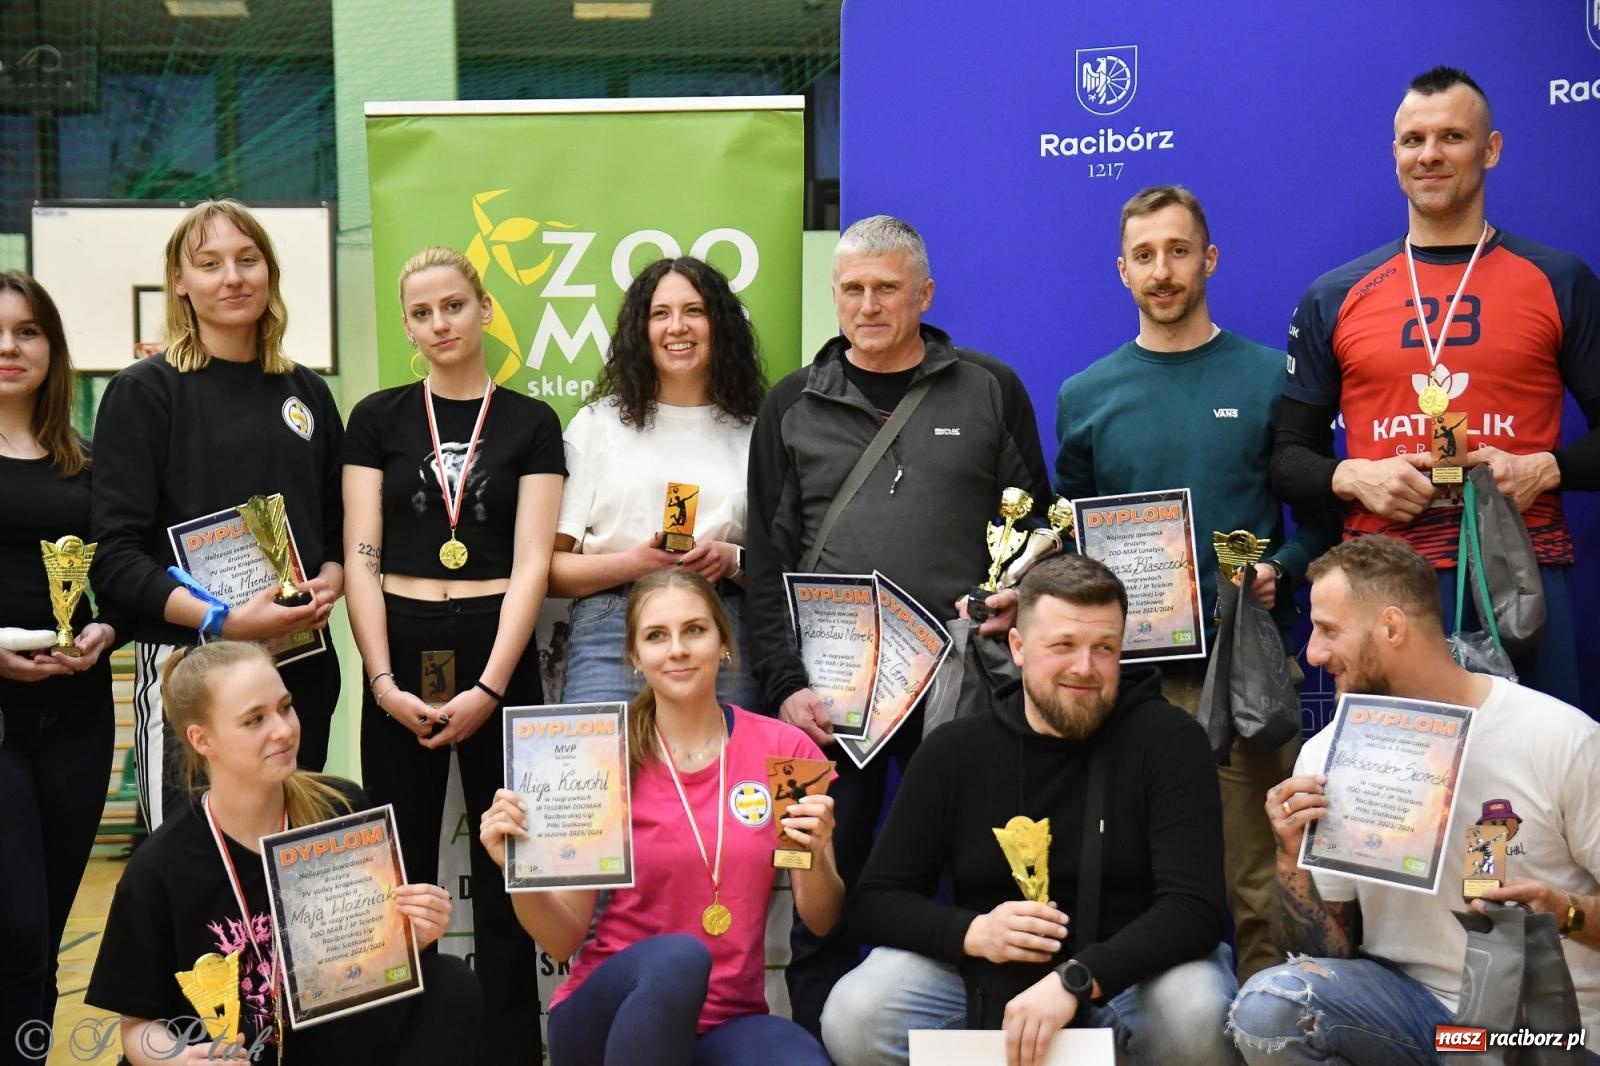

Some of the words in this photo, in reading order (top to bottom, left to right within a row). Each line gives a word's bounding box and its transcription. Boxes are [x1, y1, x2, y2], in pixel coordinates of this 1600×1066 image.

[1040, 126, 1175, 157] Racibórz
[1088, 162, 1124, 180] 1217
[540, 228, 760, 298] ZOO
[1401, 294, 1481, 349] 23
[527, 374, 595, 400] sklep
[1212, 408, 1240, 418] VANS
[1086, 504, 1179, 528] DYPLOM
[186, 521, 251, 552] DYPL
[798, 587, 871, 605] DYPLOM
[879, 590, 942, 656] DYPLOM
[517, 719, 616, 740] DYPLOM
[1350, 708, 1457, 737] DYPLOM
[554, 743, 577, 753] MVP
[279, 824, 384, 867] DYPLOM
